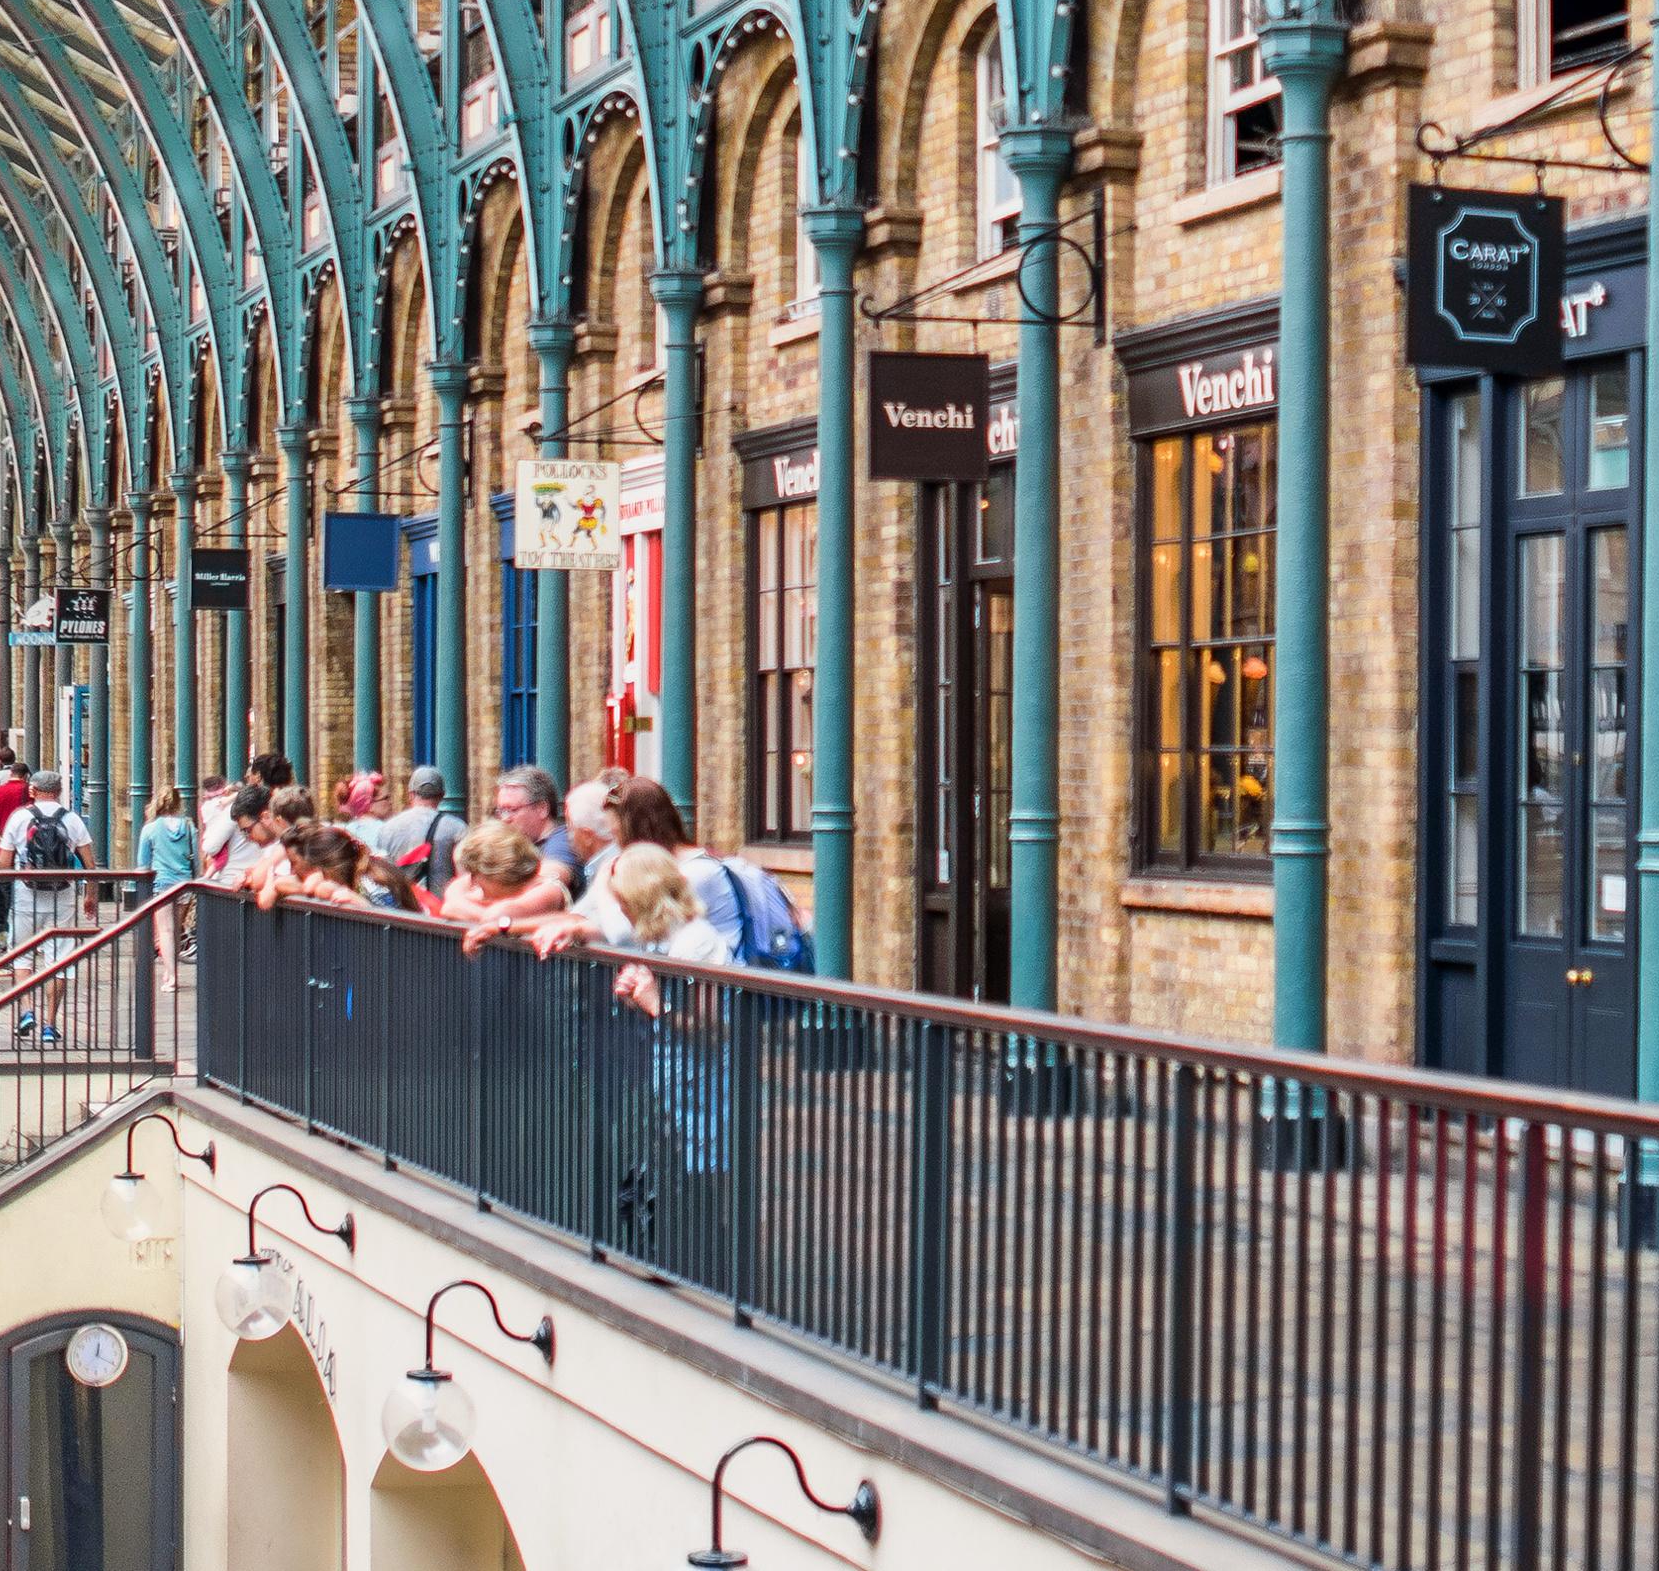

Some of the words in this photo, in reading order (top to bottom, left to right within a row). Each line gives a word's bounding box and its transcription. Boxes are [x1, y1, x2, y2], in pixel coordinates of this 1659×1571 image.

[1449, 238, 1524, 265] CARAT
[1178, 347, 1276, 418] Venchi
[883, 401, 976, 430] Venchi
[59, 619, 107, 635] PYLONES
